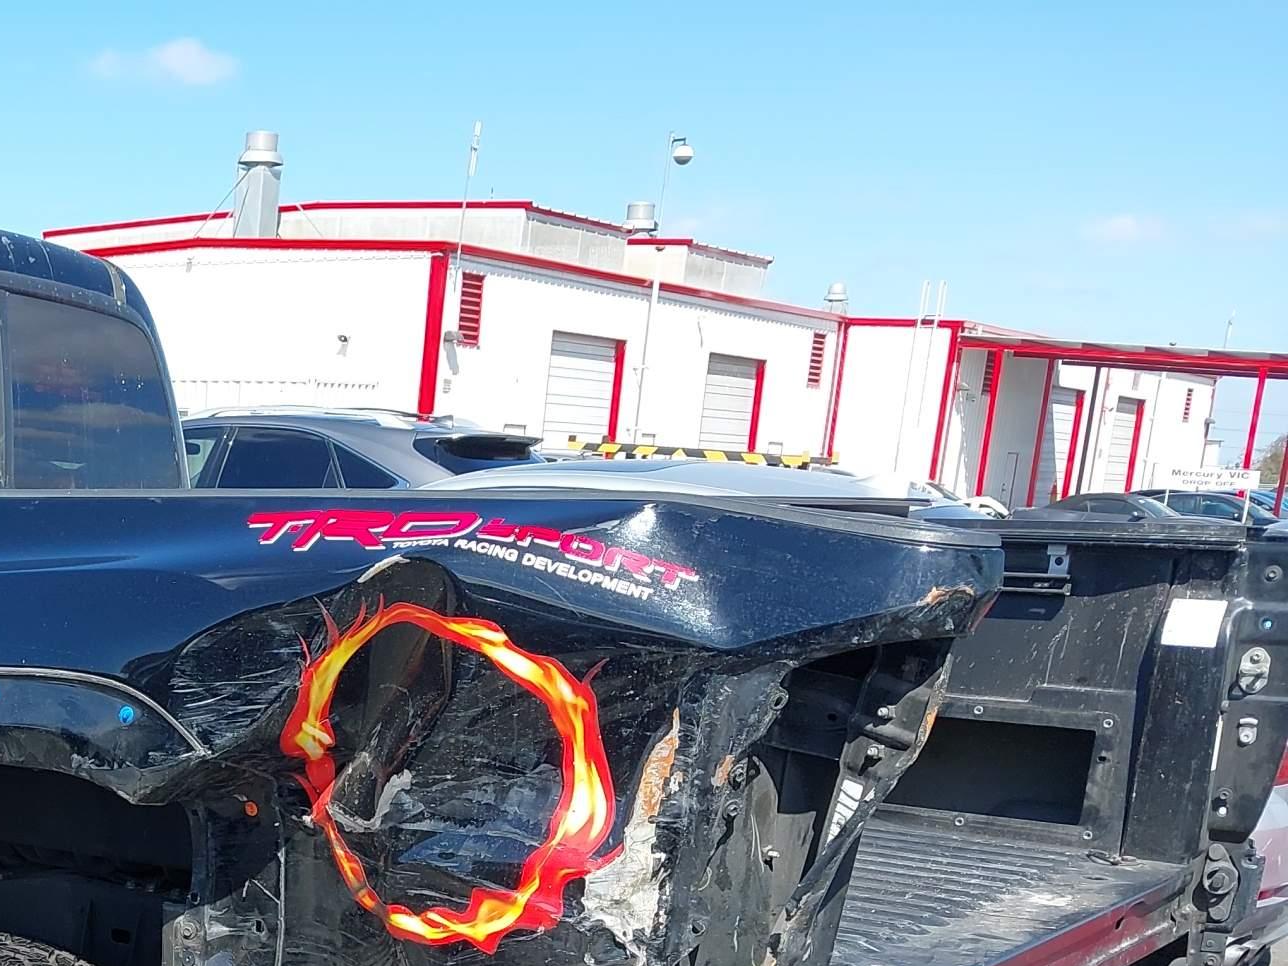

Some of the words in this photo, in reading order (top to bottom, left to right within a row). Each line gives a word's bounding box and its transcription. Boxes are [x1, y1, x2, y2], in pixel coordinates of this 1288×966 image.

[1171, 468, 1223, 480] Mercury
[1229, 472, 1250, 480] VIC
[247, 510, 484, 552] TRD
[476, 518, 700, 590] SPORT
[392, 540, 450, 550] TOYOTA
[454, 539, 519, 562] RACING
[522, 553, 654, 602] DEVELOPMENT
